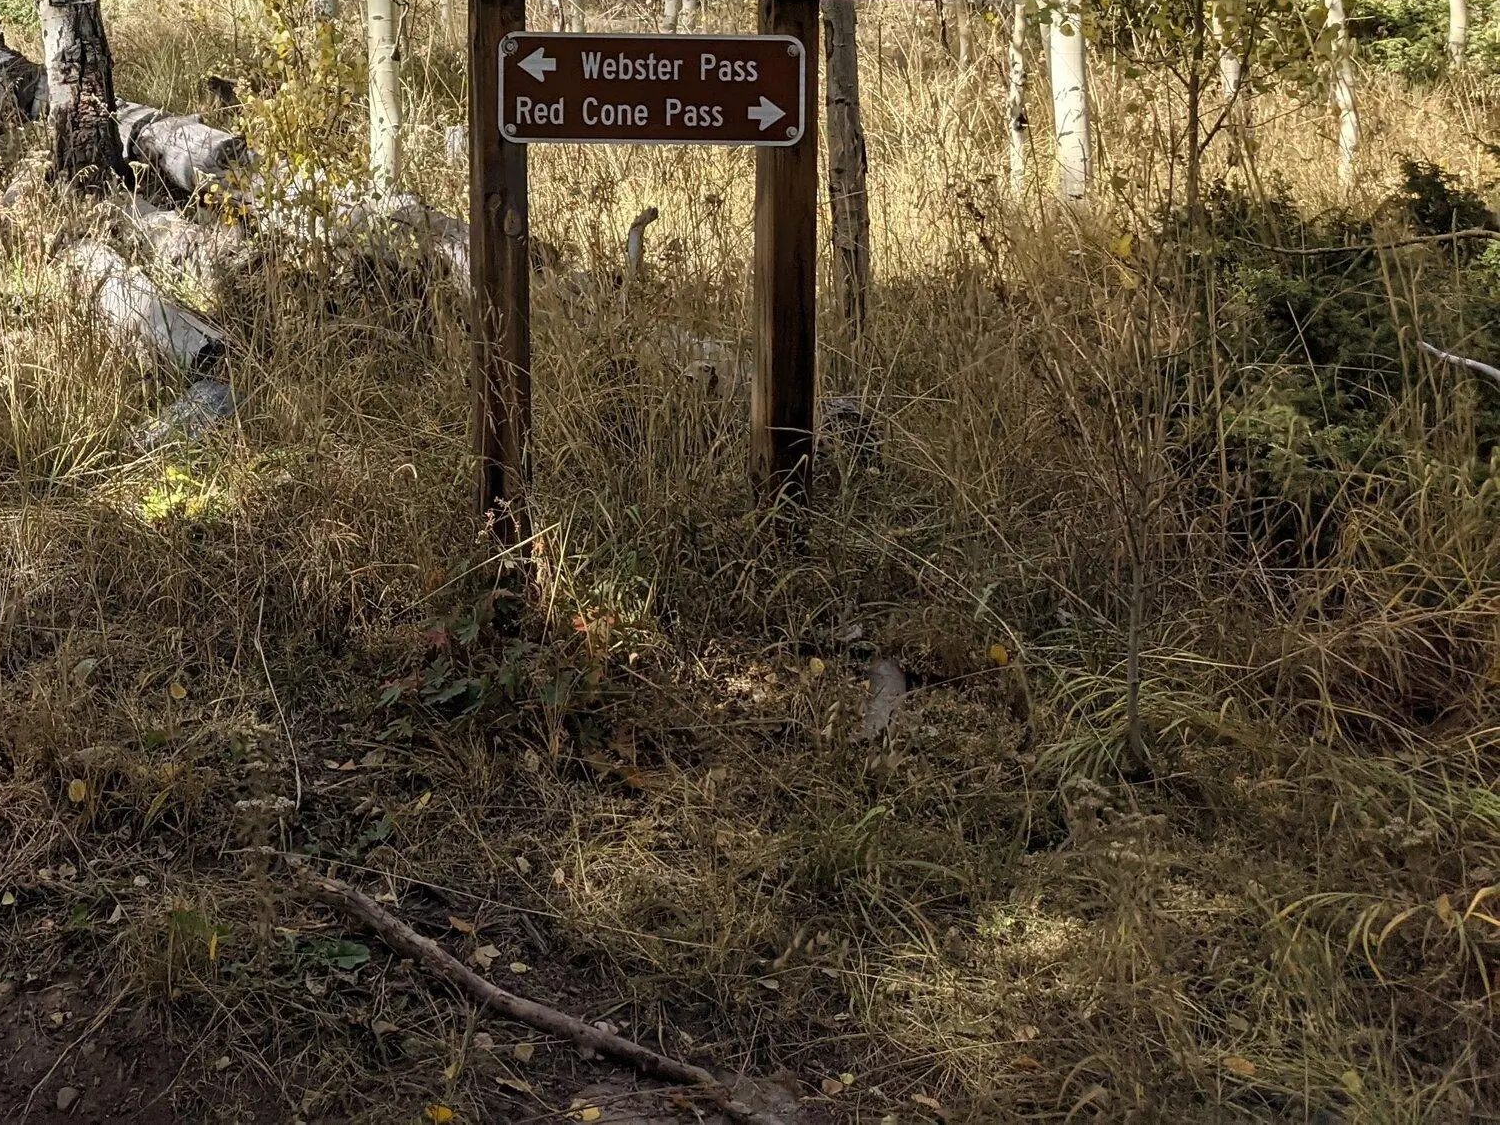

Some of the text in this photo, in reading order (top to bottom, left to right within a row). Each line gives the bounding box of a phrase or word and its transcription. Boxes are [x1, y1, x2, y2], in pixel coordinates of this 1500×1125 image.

[581, 51, 759, 82] Webster Pass
[516, 96, 724, 127] Red Cone Pass
